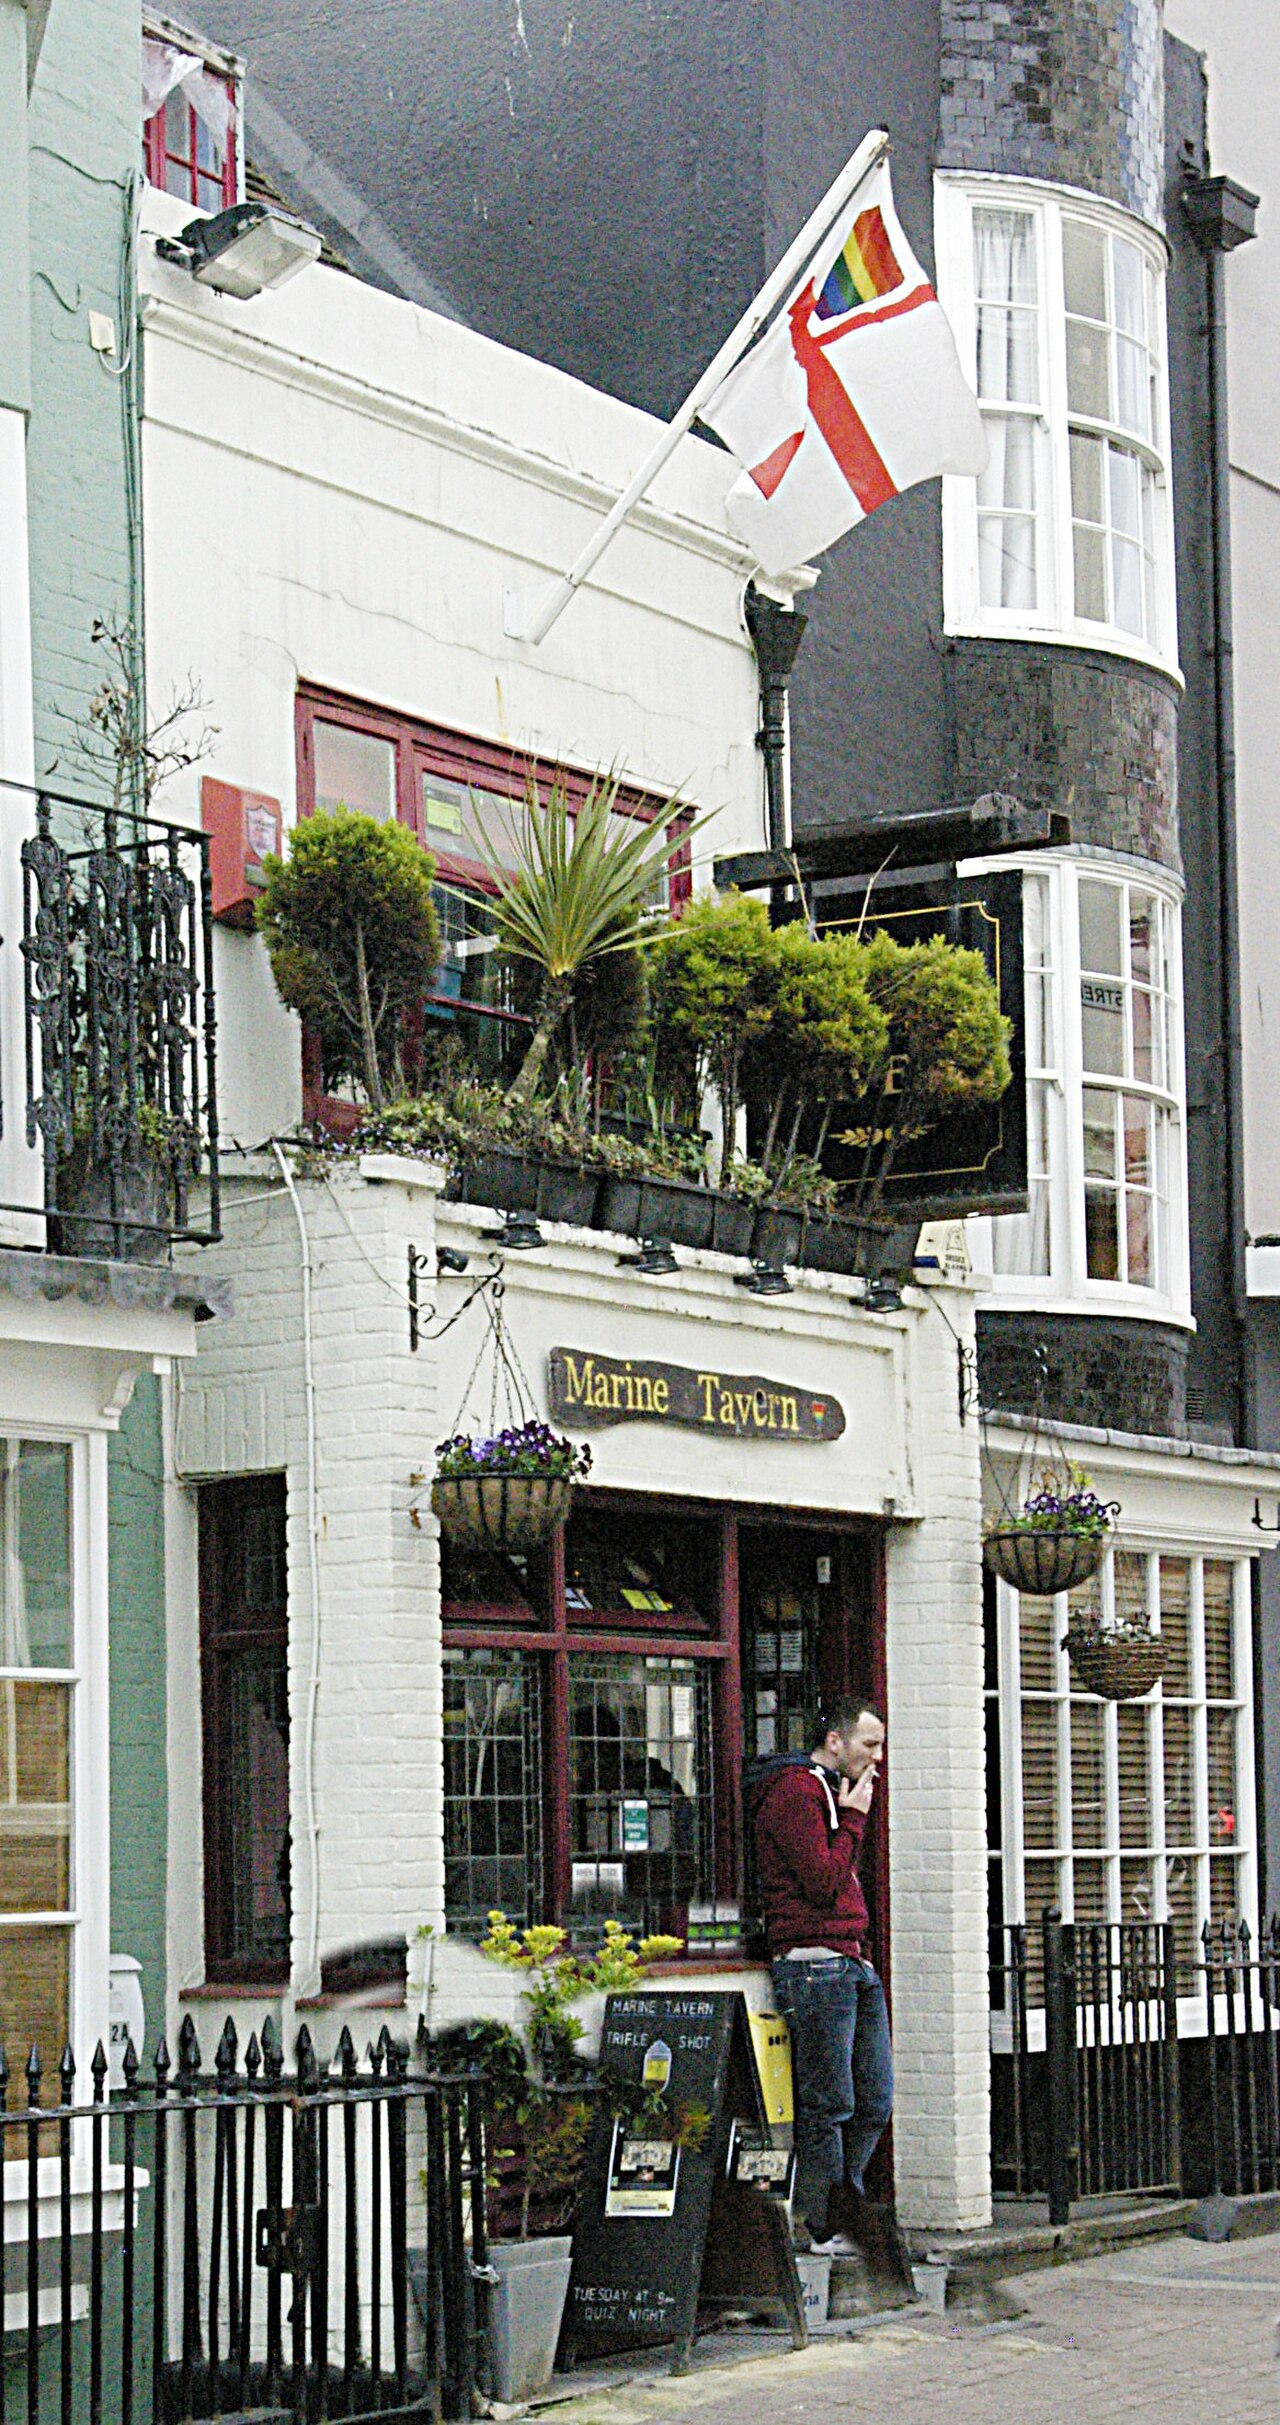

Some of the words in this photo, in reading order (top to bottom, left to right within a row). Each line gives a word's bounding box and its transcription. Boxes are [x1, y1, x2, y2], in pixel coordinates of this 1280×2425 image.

[563, 1355, 669, 1413] Marine
[697, 1373, 800, 1431] Tavern
[612, 1999, 657, 2014] MARINE
[664, 2000, 714, 2015] TAVERN
[606, 2031, 649, 2047] TRIFLE
[678, 2034, 711, 2050] SHOT
[574, 2286, 629, 2302] TUESDAY
[584, 2305, 617, 2321] QUIZ
[627, 2308, 667, 2321] NIGHT
